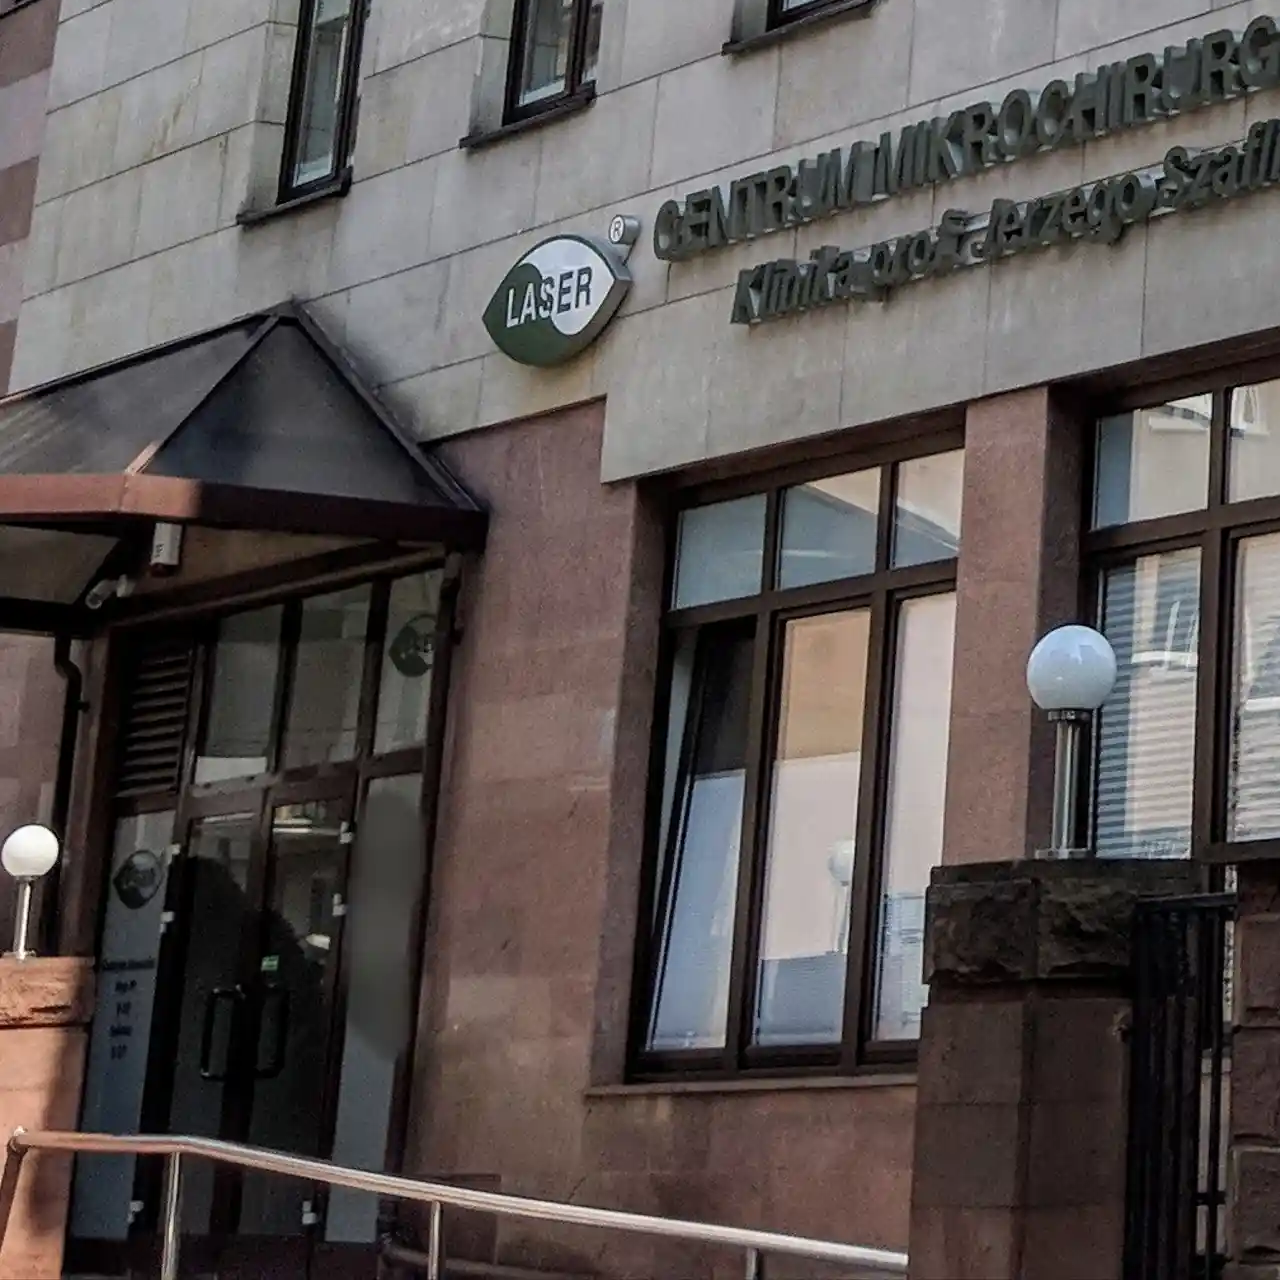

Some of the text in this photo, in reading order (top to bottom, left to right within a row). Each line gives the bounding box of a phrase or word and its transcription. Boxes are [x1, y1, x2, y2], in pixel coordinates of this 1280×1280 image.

[653, 139, 866, 261] CENTRUM
[506, 265, 593, 329] LASER
[729, 244, 864, 325] Klinika
